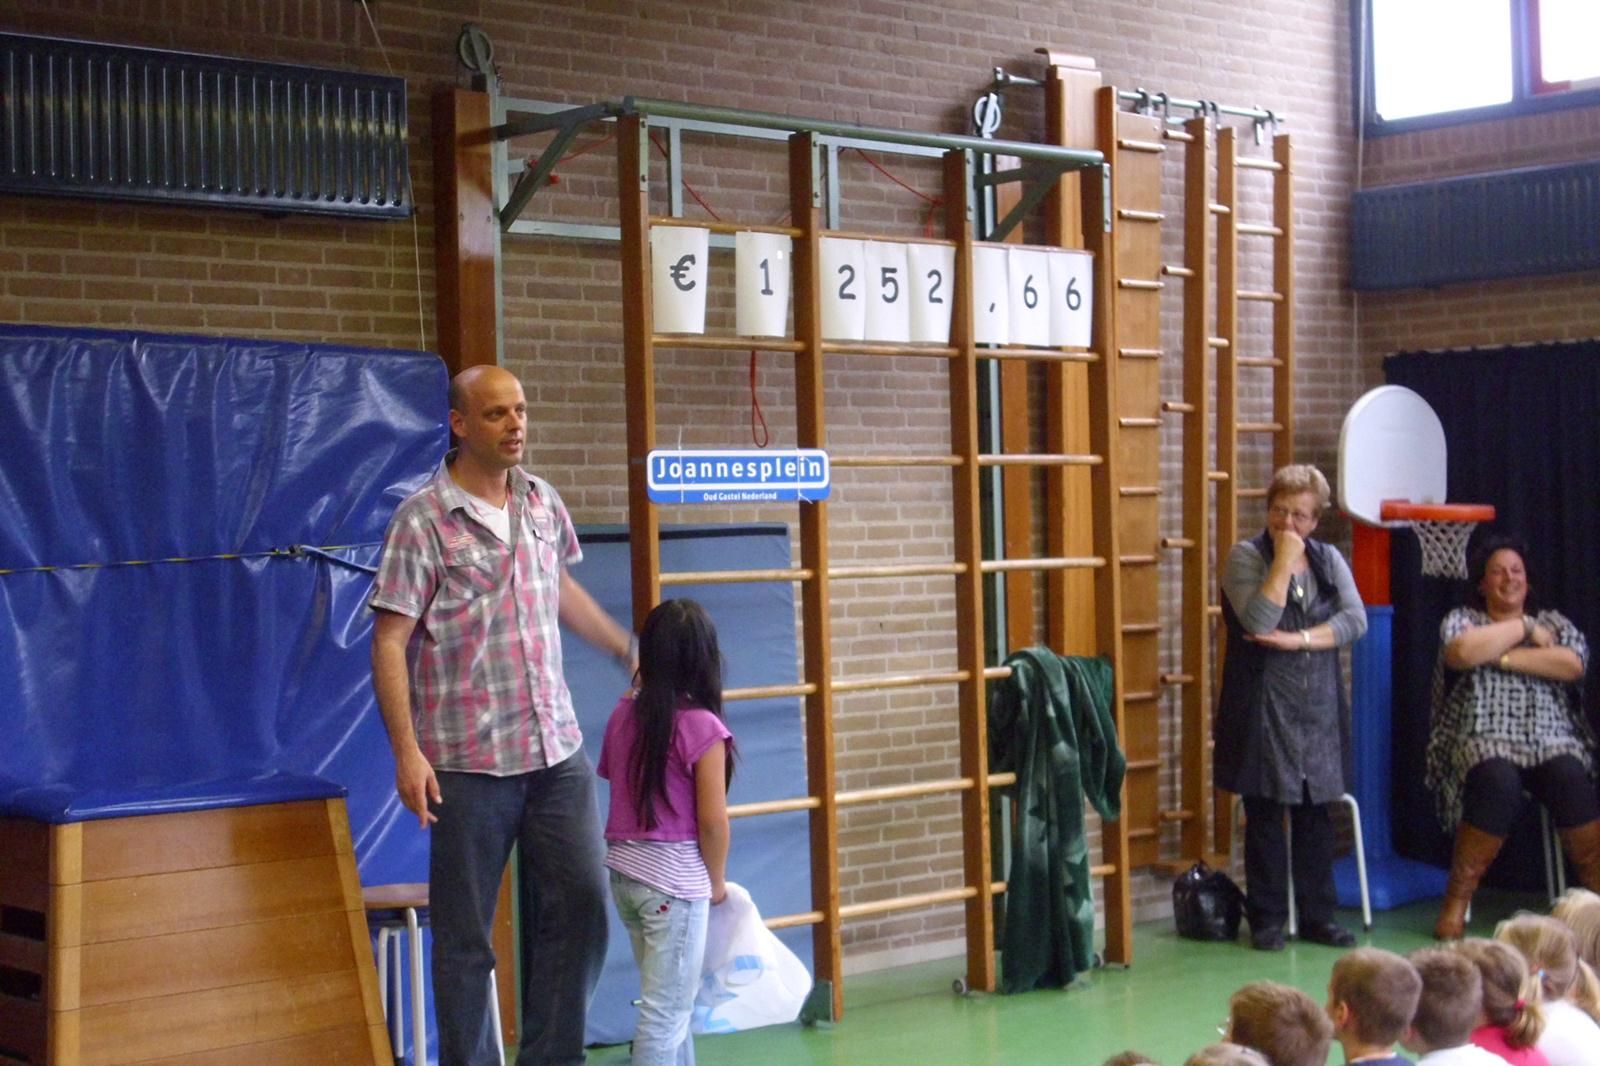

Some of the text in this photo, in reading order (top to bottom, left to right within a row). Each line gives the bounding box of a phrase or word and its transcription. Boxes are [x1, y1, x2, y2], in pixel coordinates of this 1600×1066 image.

[669, 254, 696, 292] €
[657, 457, 821, 482] Joannesplein
[703, 492, 717, 502] Oud
[742, 491, 777, 501] Nederland
